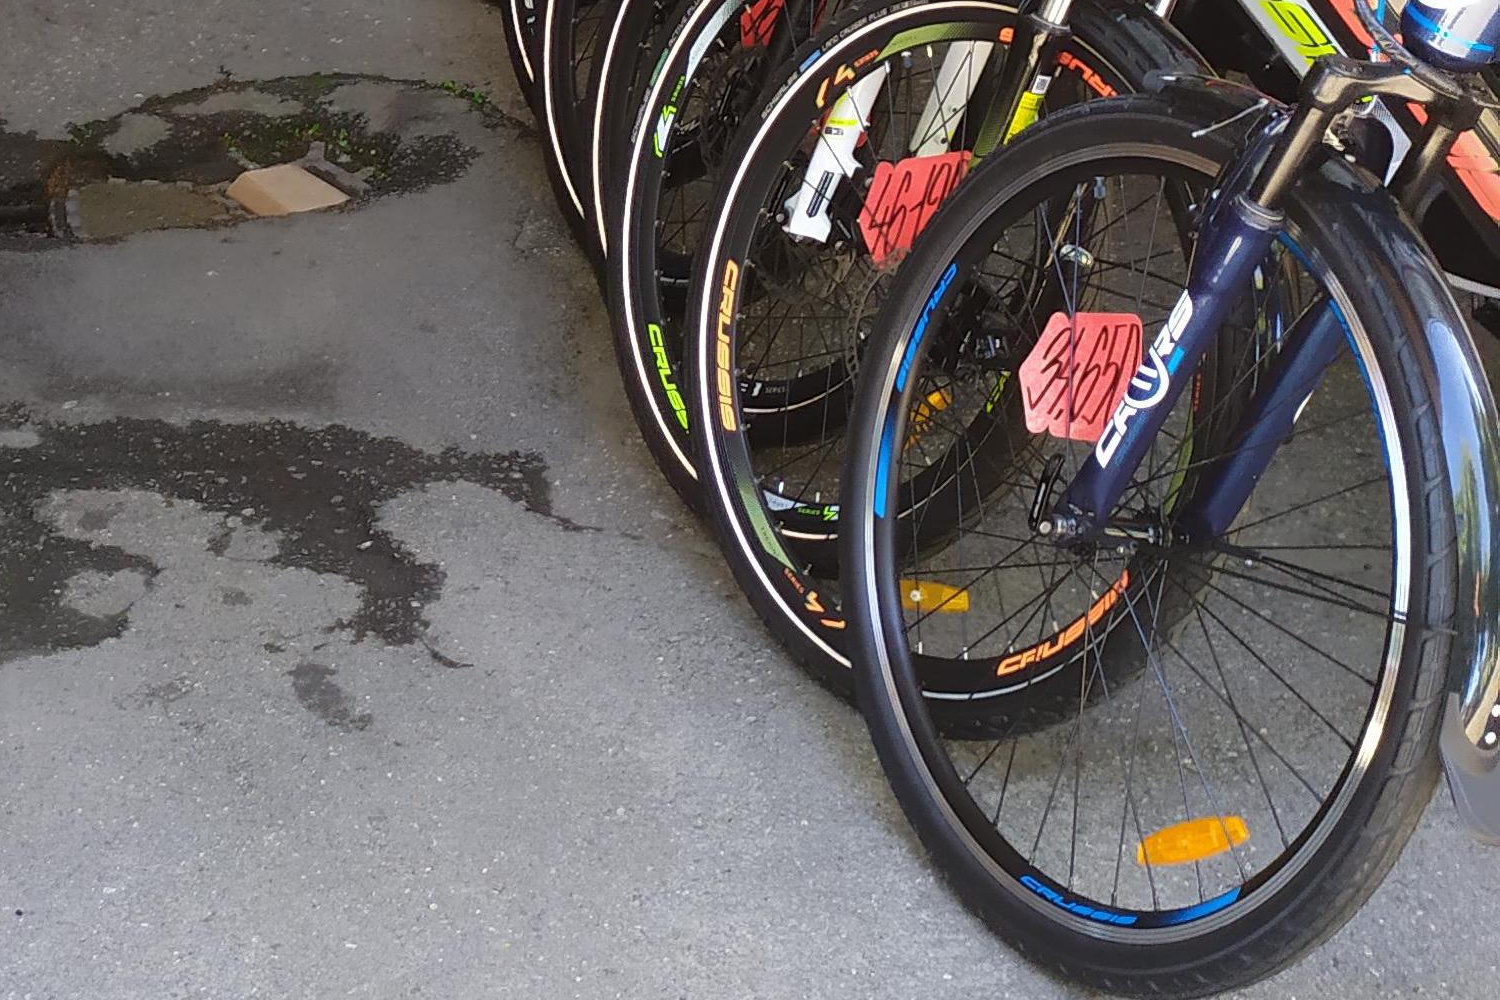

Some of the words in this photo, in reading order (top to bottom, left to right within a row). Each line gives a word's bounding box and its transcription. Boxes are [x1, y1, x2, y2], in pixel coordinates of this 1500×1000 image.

[717, 258, 740, 432] CRUSSIS
[895, 262, 958, 393] CRUSSIS
[1019, 874, 1140, 926] CRUSSIS
